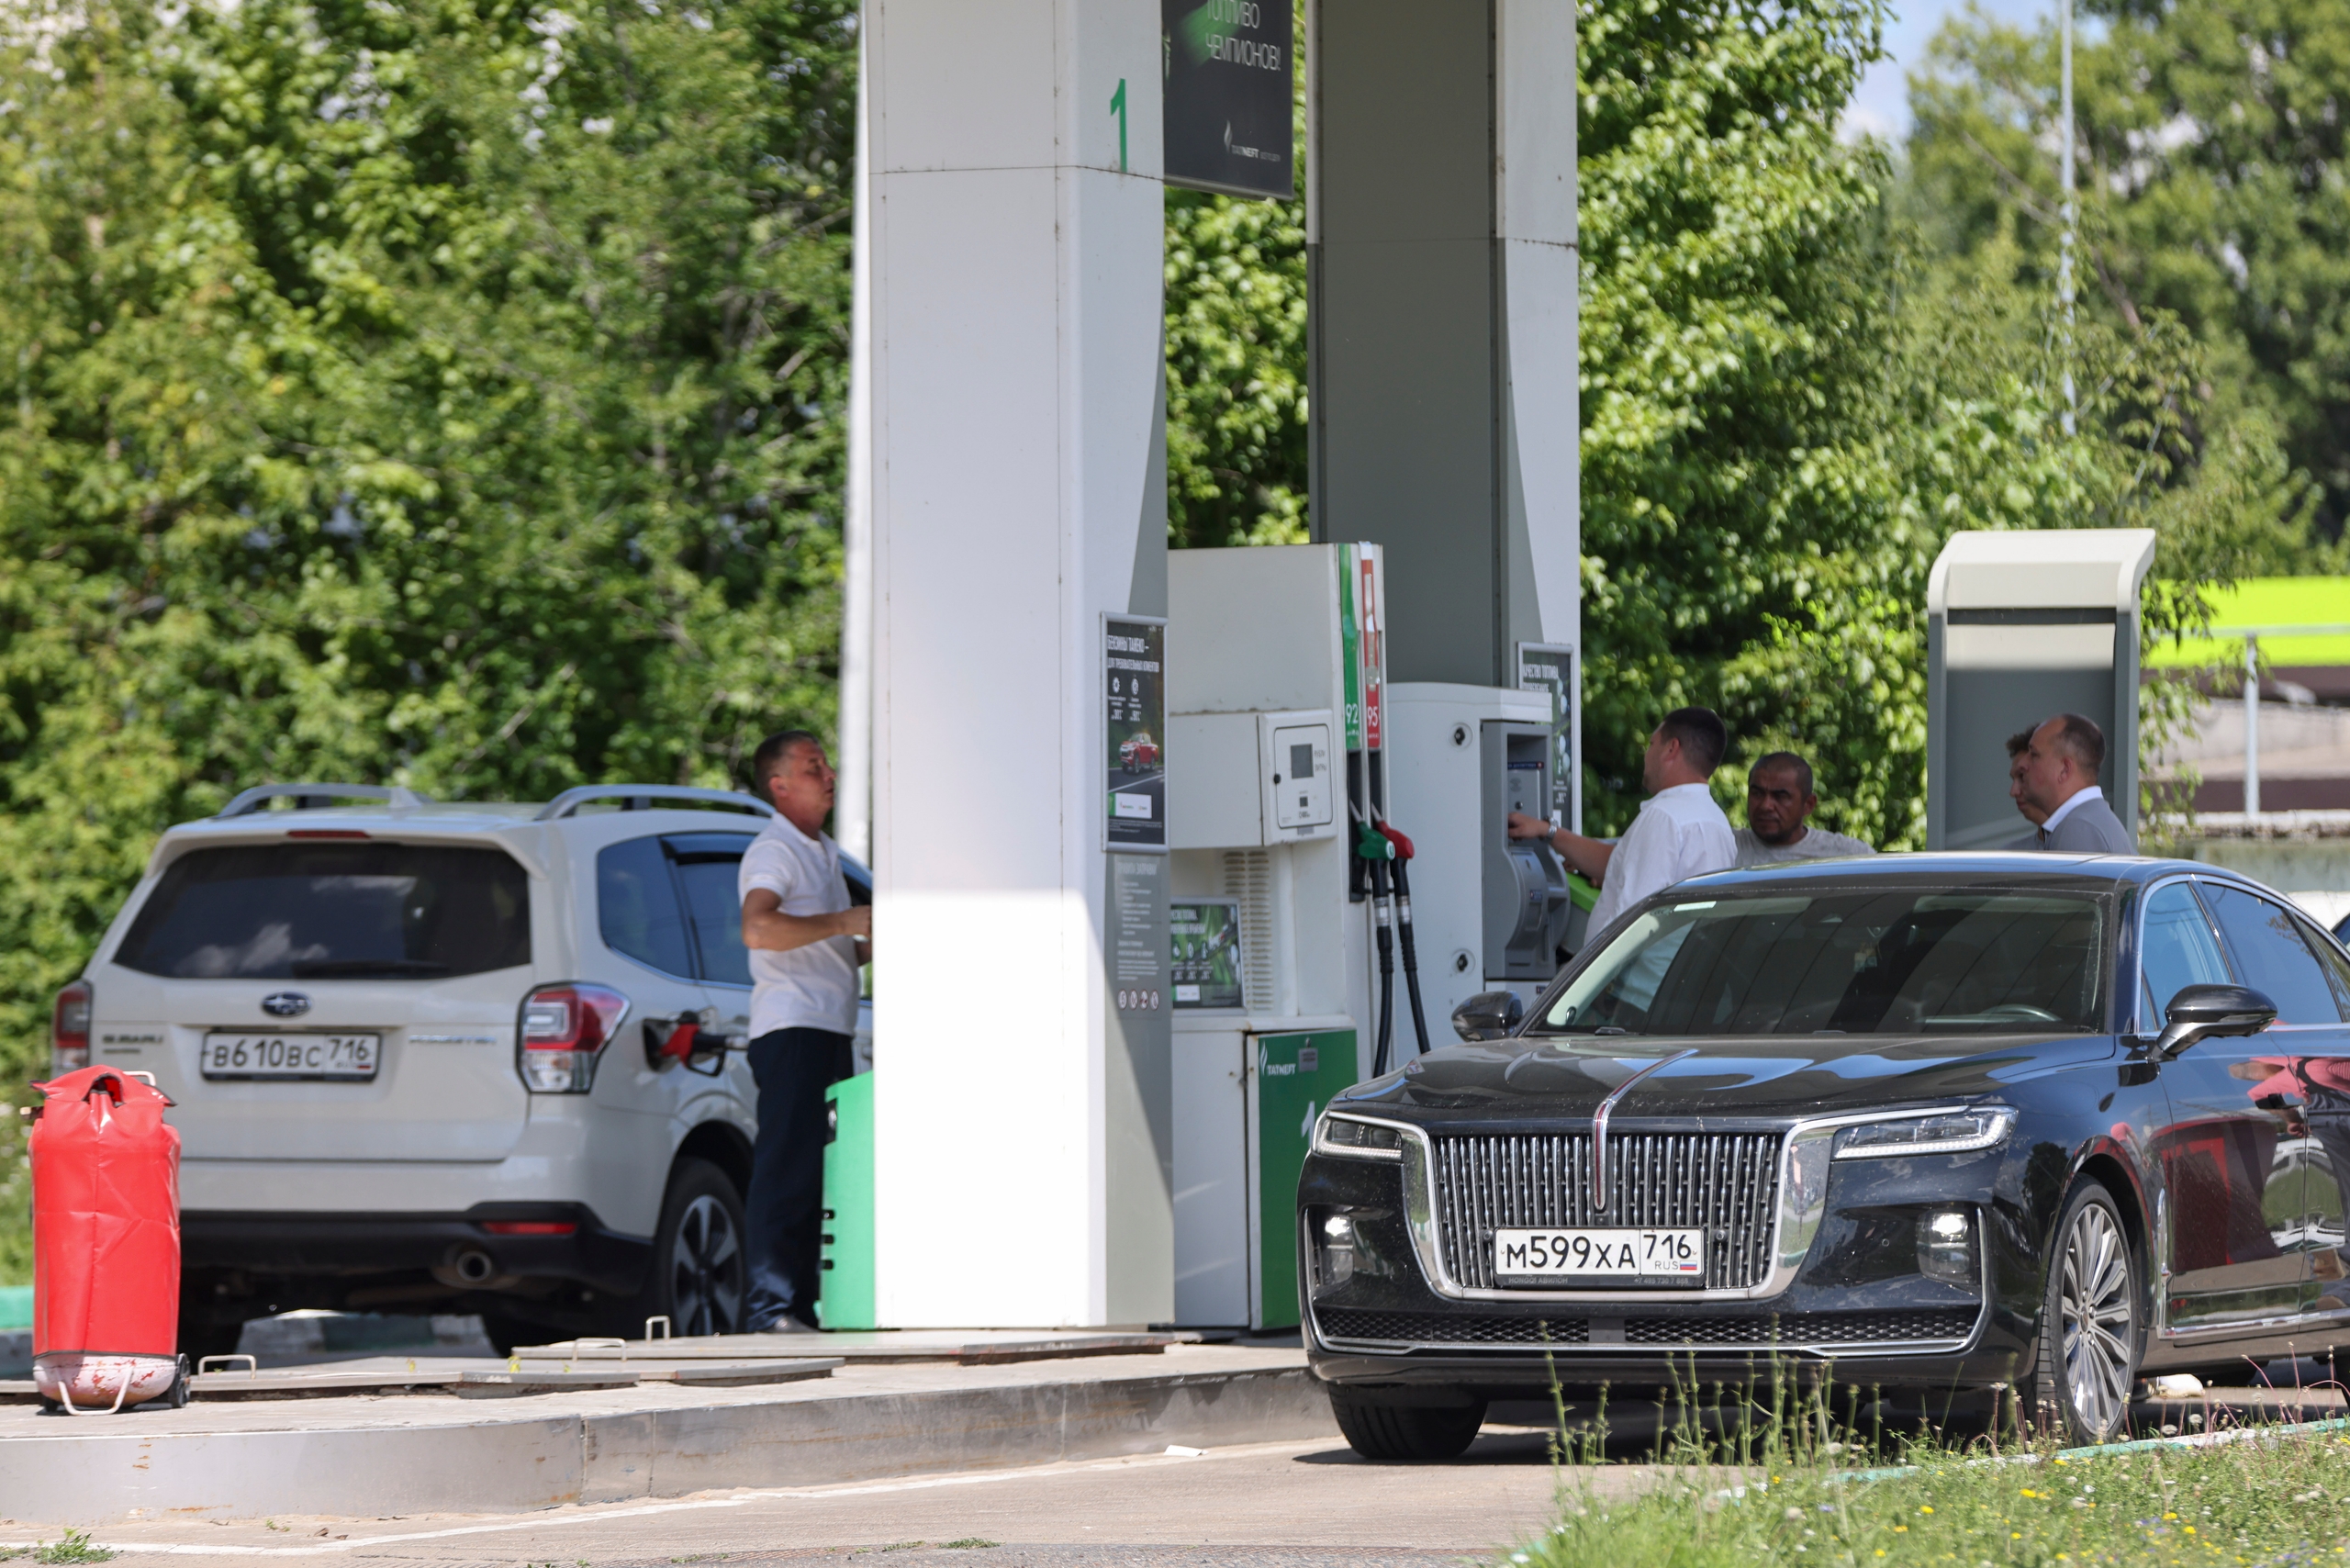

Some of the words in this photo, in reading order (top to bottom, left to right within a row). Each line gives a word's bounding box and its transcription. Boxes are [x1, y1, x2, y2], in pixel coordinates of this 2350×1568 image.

[1205, 32, 1281, 72] ЧЕМПИОНОВ!
[1110, 77, 1128, 174] 1
[1346, 703, 1359, 723] 92
[1367, 706, 1379, 726] 95
[328, 1038, 369, 1061] 716
[1506, 1236, 1637, 1269] М599ХА
[1642, 1234, 1692, 1260] 716
[1654, 1260, 1679, 1271] RUS
